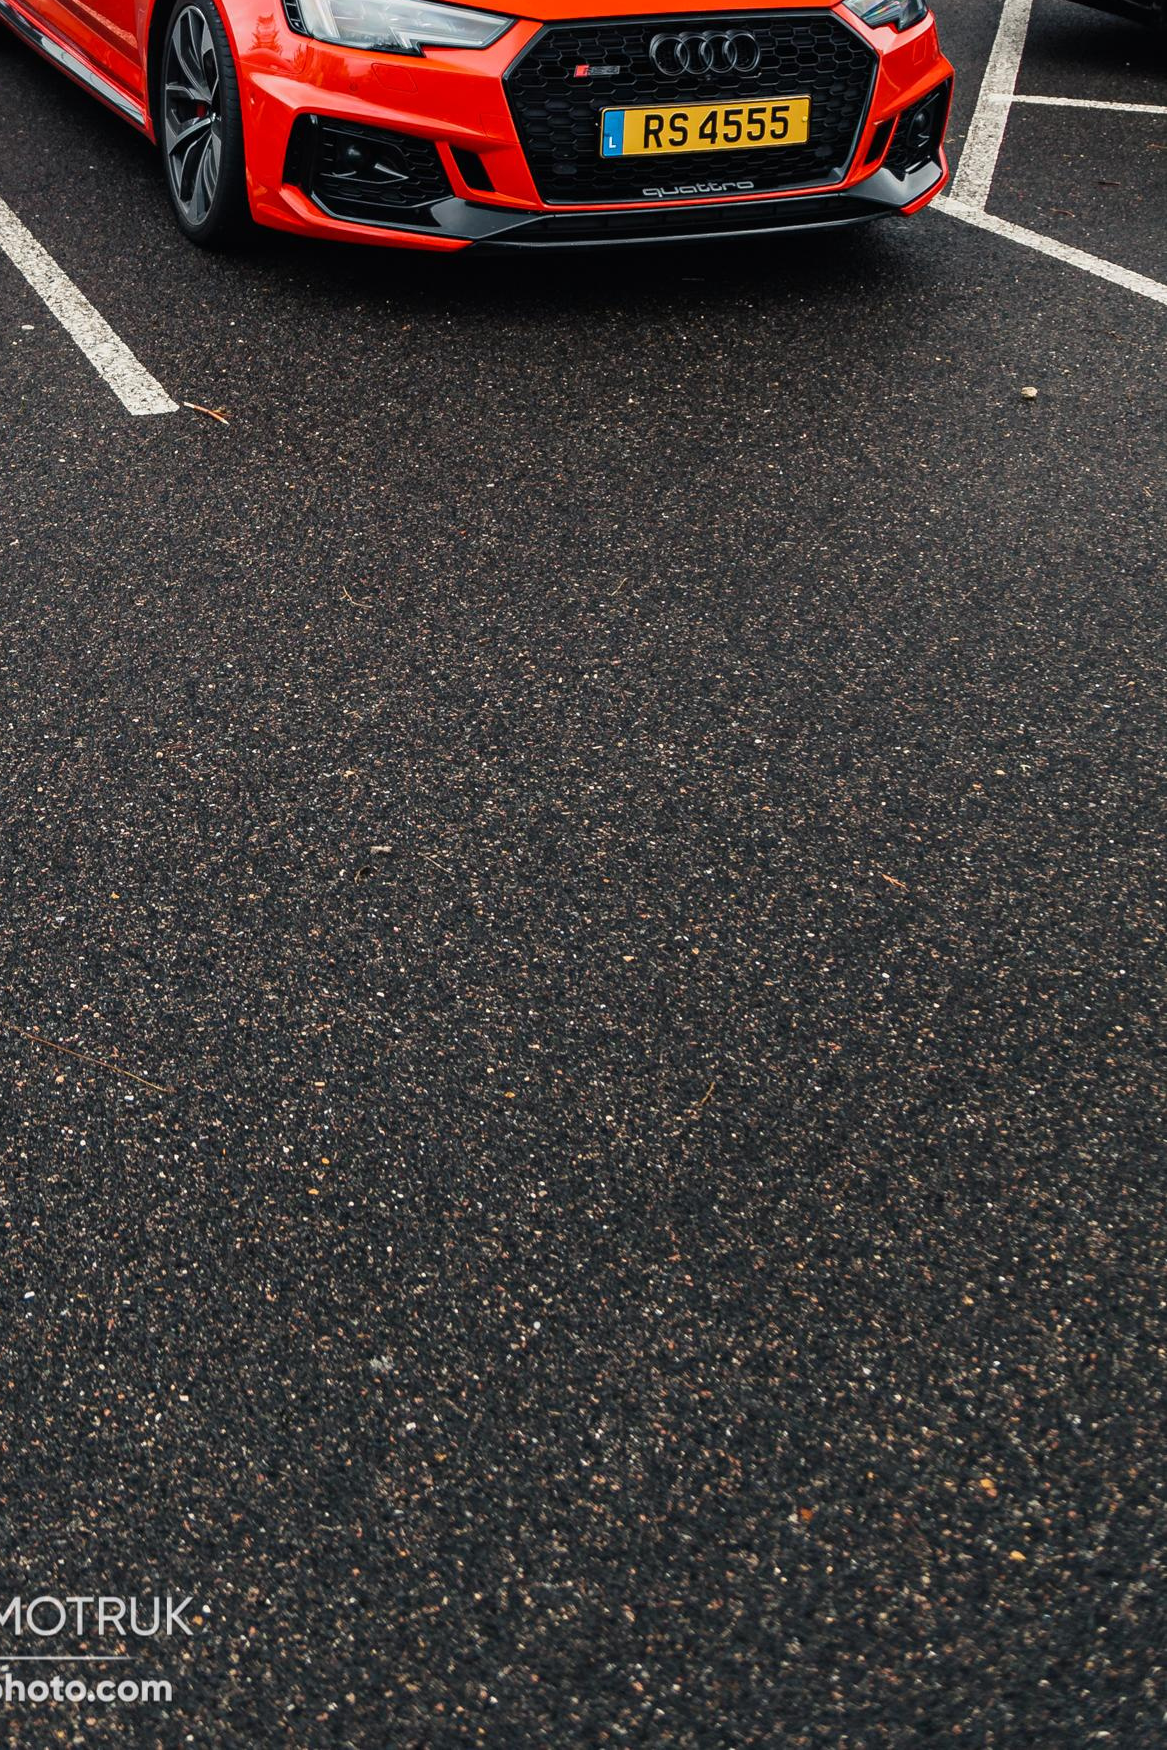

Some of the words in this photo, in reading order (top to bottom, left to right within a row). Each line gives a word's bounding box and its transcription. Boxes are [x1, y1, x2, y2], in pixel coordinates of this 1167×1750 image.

[608, 136, 617, 149] L
[643, 112, 689, 149] RS
[698, 105, 790, 145] 4555
[642, 180, 754, 198] quattro
